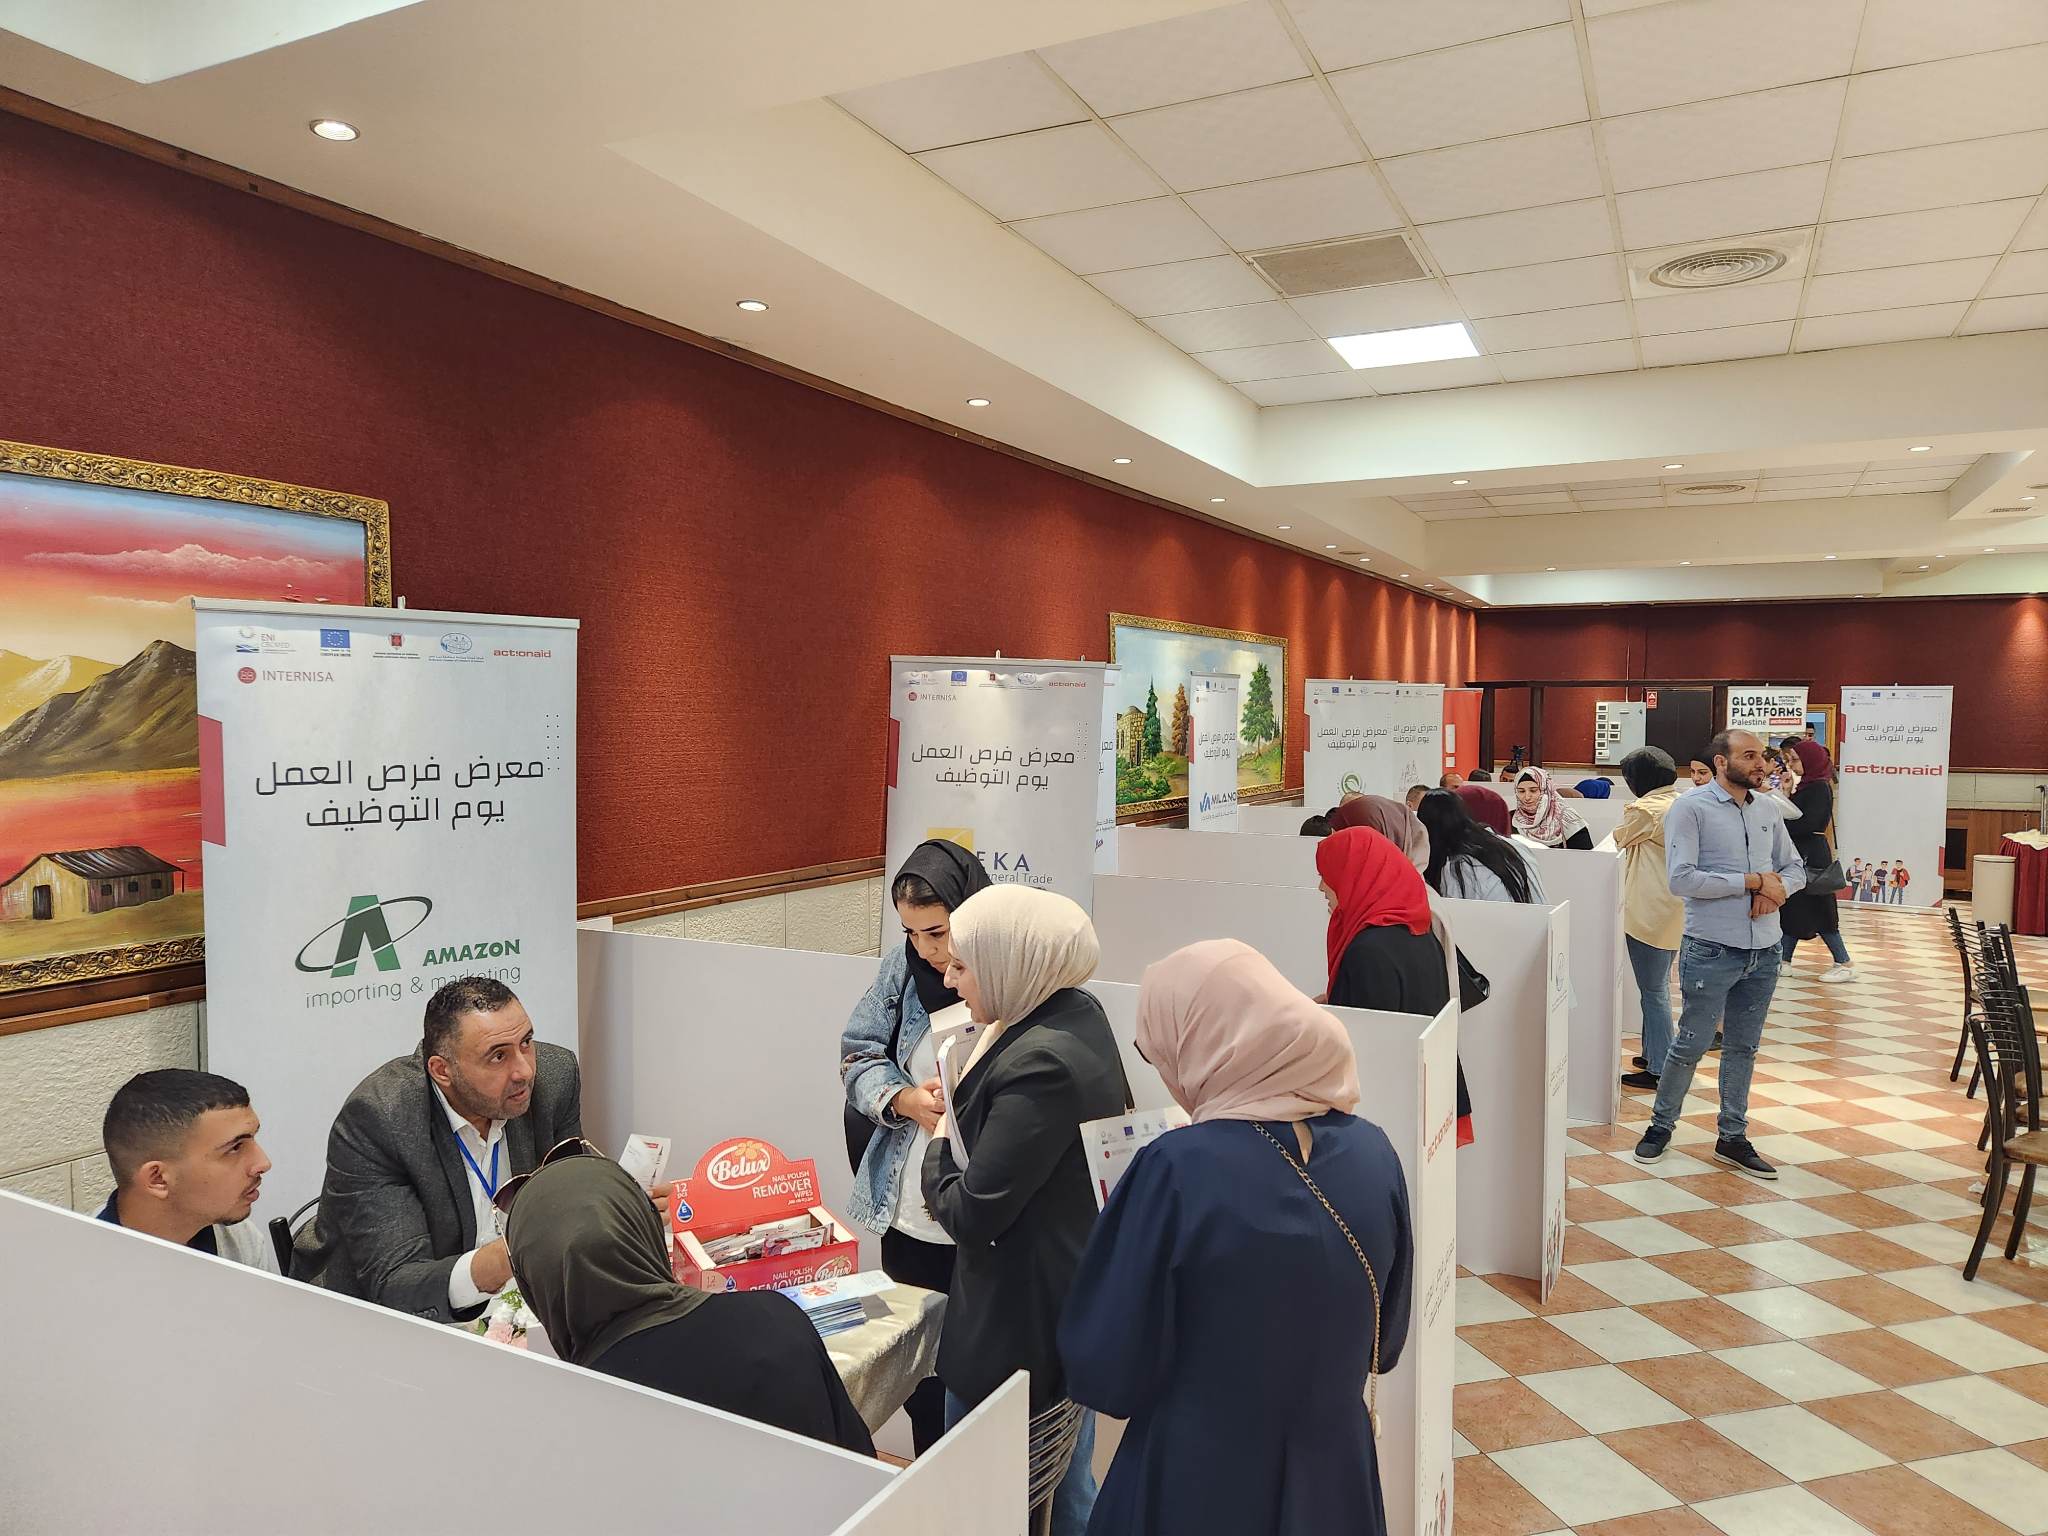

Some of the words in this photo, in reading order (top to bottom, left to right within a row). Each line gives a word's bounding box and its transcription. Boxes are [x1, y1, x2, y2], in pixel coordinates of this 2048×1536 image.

[262, 670, 334, 682] INTERNISA
[1732, 696, 1777, 706] GLOBAL
[1731, 718, 1767, 726] Palestine
[1732, 707, 1803, 717] PLATFORMS
[912, 744, 963, 764] العمل
[970, 745, 1012, 766] فرص
[1019, 747, 1075, 768] معرض
[256, 760, 352, 795] العمل
[368, 755, 440, 791] فرص
[455, 755, 544, 788] معرض
[936, 767, 1010, 788] التوظيف
[1016, 774, 1049, 792] يوم
[306, 796, 439, 832] التوظيف
[452, 800, 504, 830] يوم
[977, 850, 1030, 872] EKA
[988, 872, 1019, 883] neral
[1022, 873, 1053, 884] Trade
[422, 938, 521, 967] AMAZON
[306, 982, 402, 1009] importing
[410, 976, 424, 993] &
[712, 1156, 768, 1182] Belux
[771, 1174, 787, 1183] NAIL
[787, 1170, 810, 1181] POLISH
[675, 1183, 688, 1193] 12
[752, 1178, 812, 1199] REMOVER
[793, 1190, 814, 1199] WIPES
[772, 1271, 789, 1280] NAIL
[789, 1266, 813, 1276] POLISH
